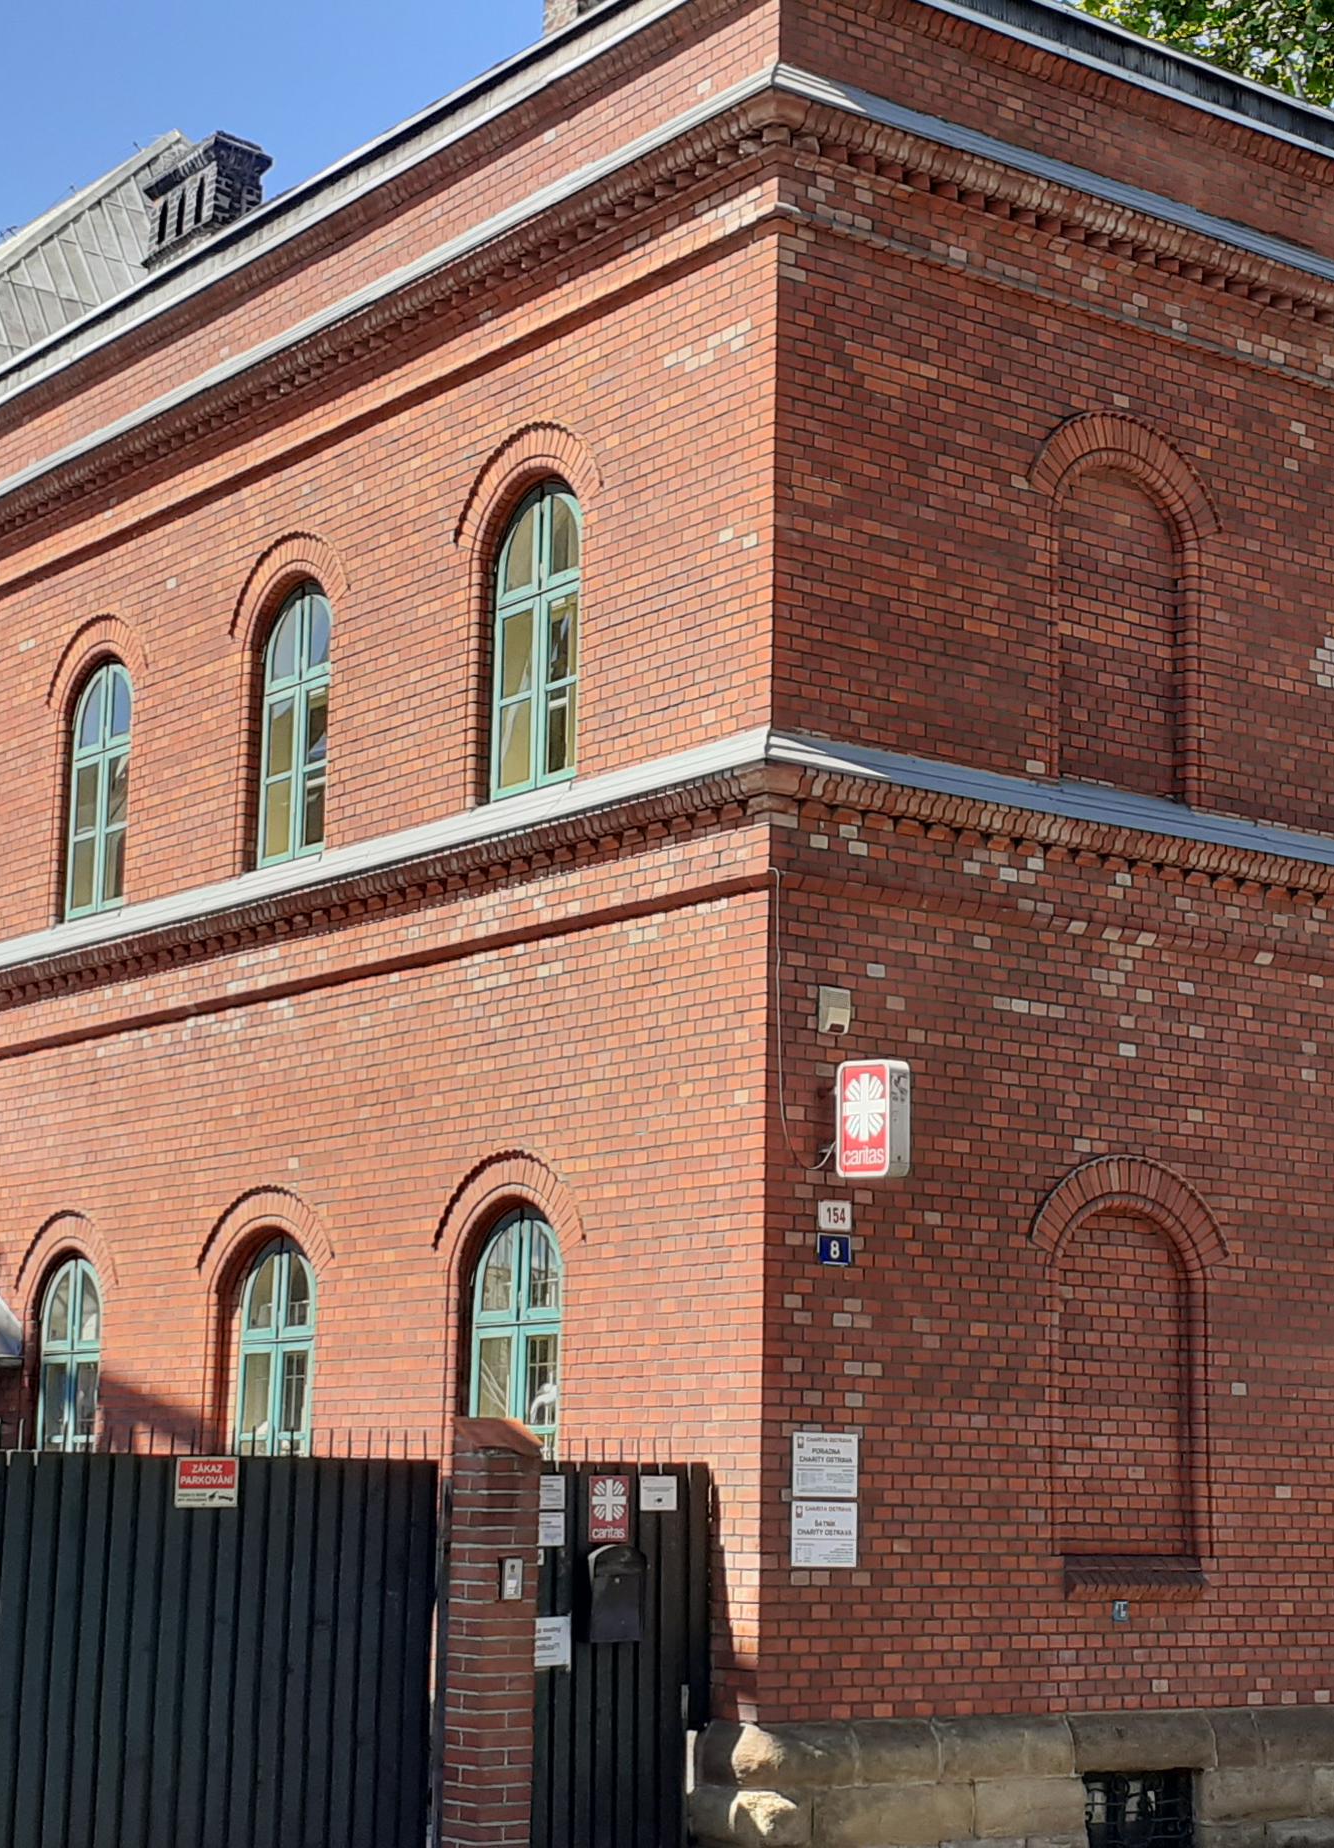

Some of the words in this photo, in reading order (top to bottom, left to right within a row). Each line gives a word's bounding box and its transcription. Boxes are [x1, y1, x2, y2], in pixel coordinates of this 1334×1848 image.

[842, 1145, 885, 1166] caritas
[827, 1207, 846, 1223] 154
[830, 1240, 840, 1259] 8
[799, 1455, 825, 1463] CHARITY
[826, 1456, 853, 1464] OSTRAVA
[192, 1462, 223, 1473] ZÁKAZ
[180, 1475, 234, 1485] PARKOVÁNÍ
[591, 1525, 626, 1540] caritas
[797, 1528, 824, 1536] CHARITY
[825, 1528, 853, 1536] OSTRAVA
